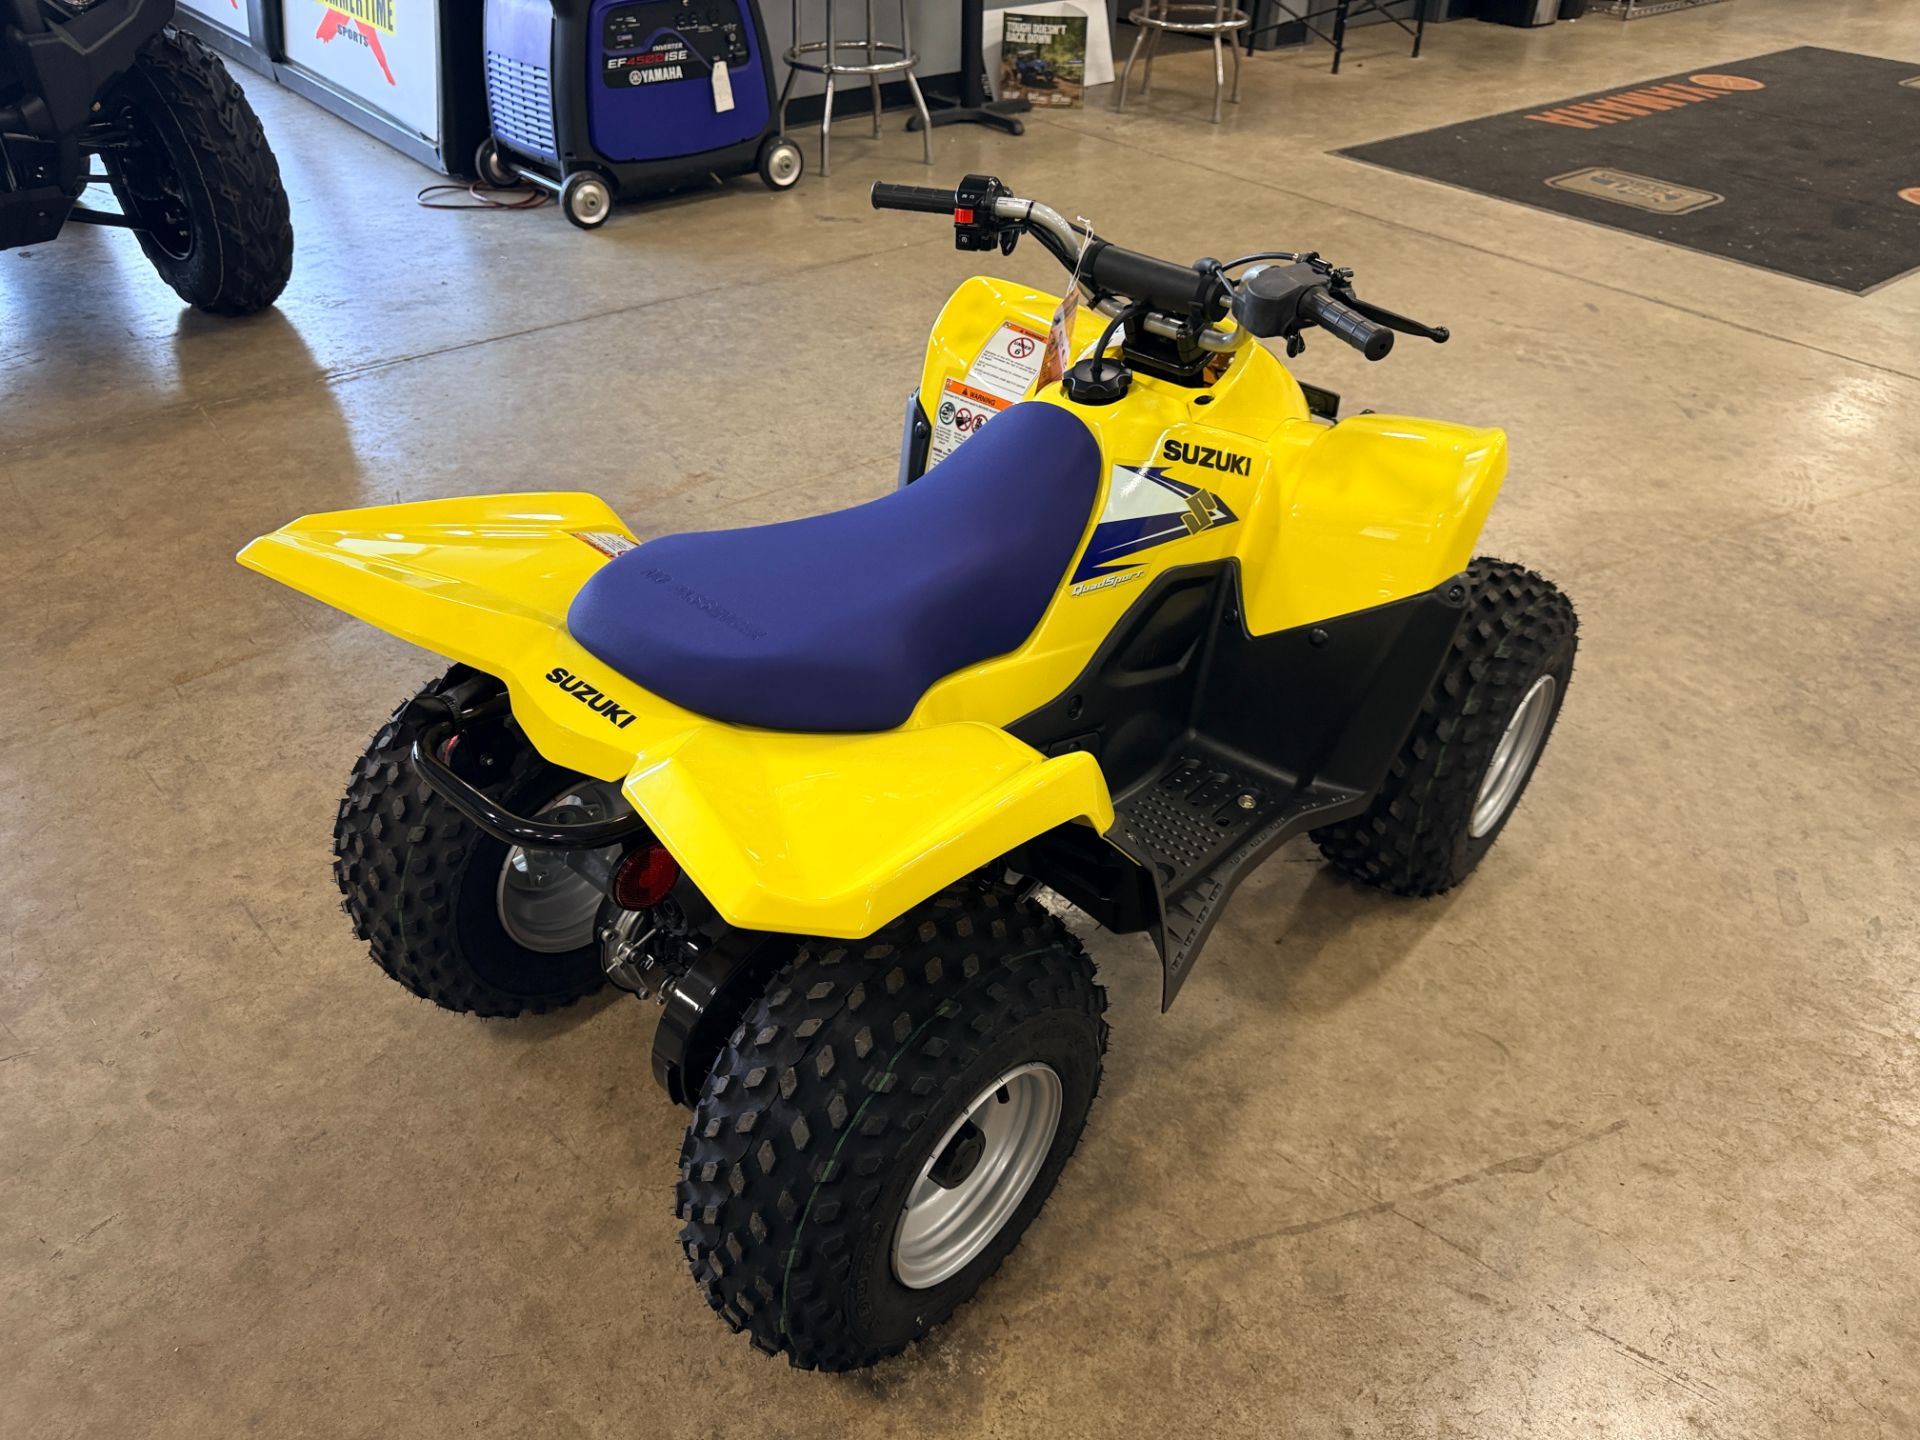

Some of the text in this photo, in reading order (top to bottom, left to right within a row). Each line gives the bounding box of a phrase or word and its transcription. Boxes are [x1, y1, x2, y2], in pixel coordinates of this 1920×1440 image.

[337, 24, 369, 47] SPORTS
[652, 42, 683, 52] INVERTER
[642, 65, 683, 83] YAMAHA
[1524, 83, 1732, 129] YAMAHA
[970, 392, 996, 406] WARNING
[1163, 439, 1252, 477] SUZUKI
[545, 667, 638, 729] SUZUKI
